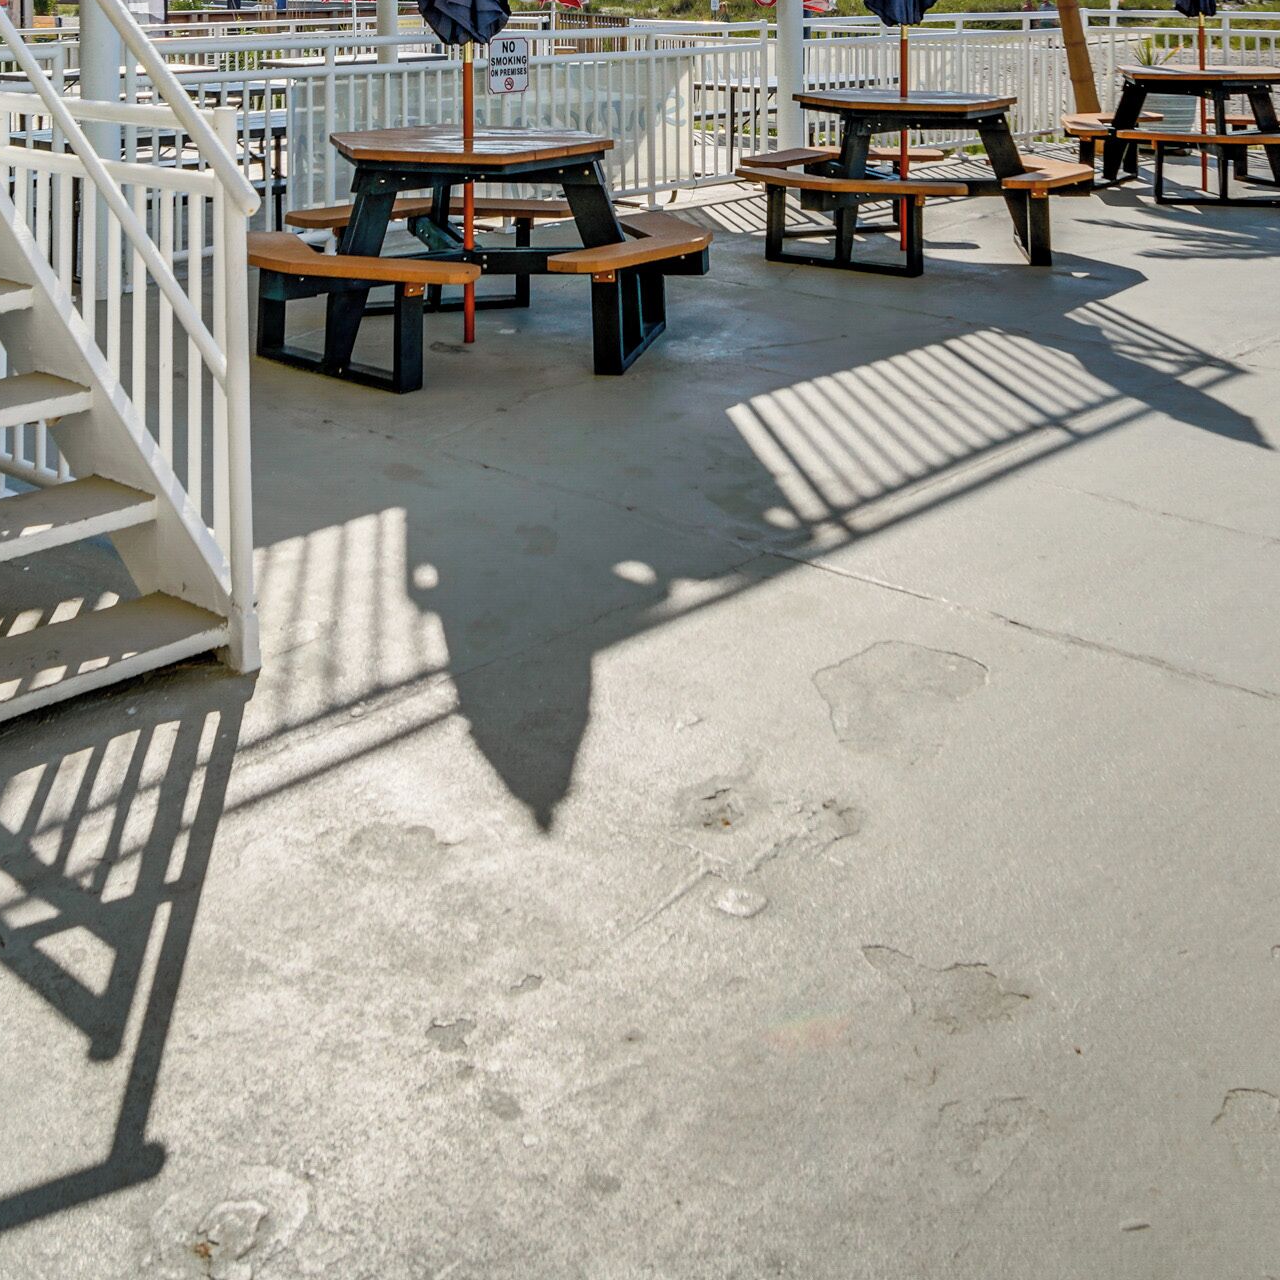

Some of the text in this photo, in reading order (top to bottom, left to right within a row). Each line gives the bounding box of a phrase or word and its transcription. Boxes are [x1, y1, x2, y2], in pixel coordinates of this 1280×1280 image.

[502, 40, 516, 53] NO
[490, 55, 527, 67] SMOKING
[490, 69, 499, 77] ON
[500, 67, 527, 77] PREMISES
